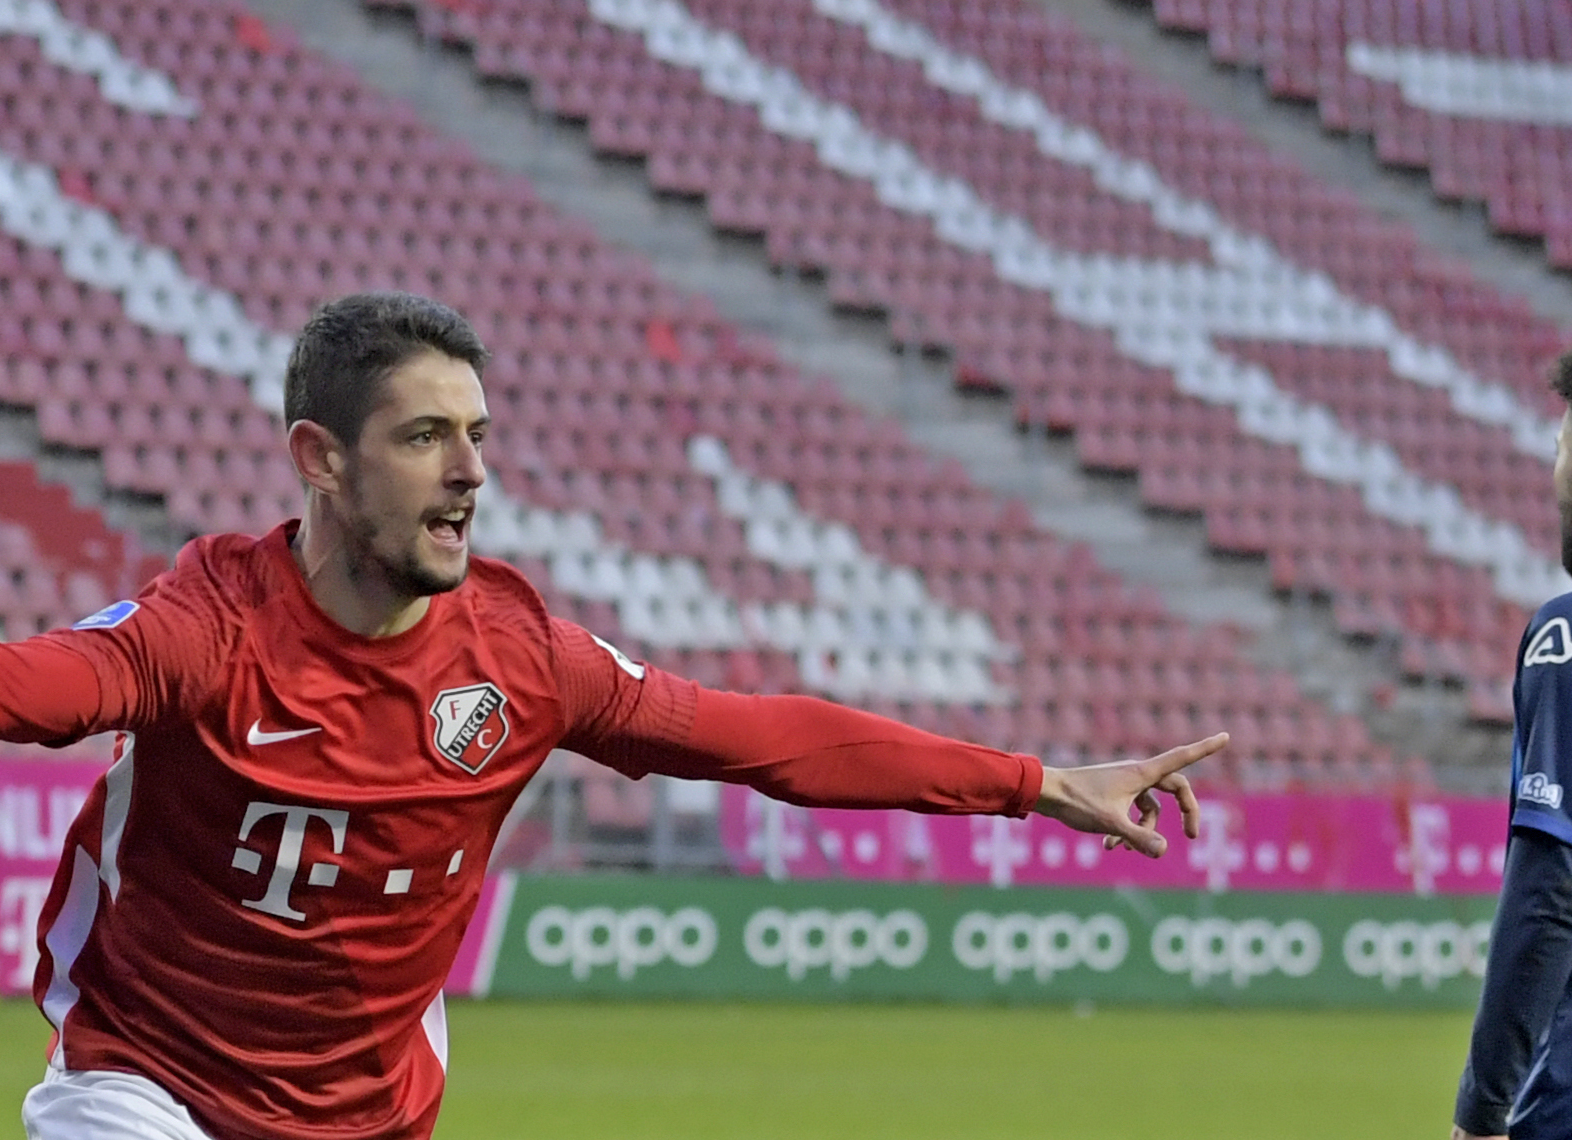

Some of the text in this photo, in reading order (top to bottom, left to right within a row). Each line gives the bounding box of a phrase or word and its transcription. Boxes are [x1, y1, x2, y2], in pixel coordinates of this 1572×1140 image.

[448, 691, 498, 757] UTRECHT
[449, 700, 461, 720] F
[476, 729, 493, 749] C
[231, 801, 349, 922] T
[526, 906, 719, 982] oppo
[743, 907, 928, 984] oppo
[952, 911, 1128, 985] oppo
[1150, 914, 1323, 989] oppo
